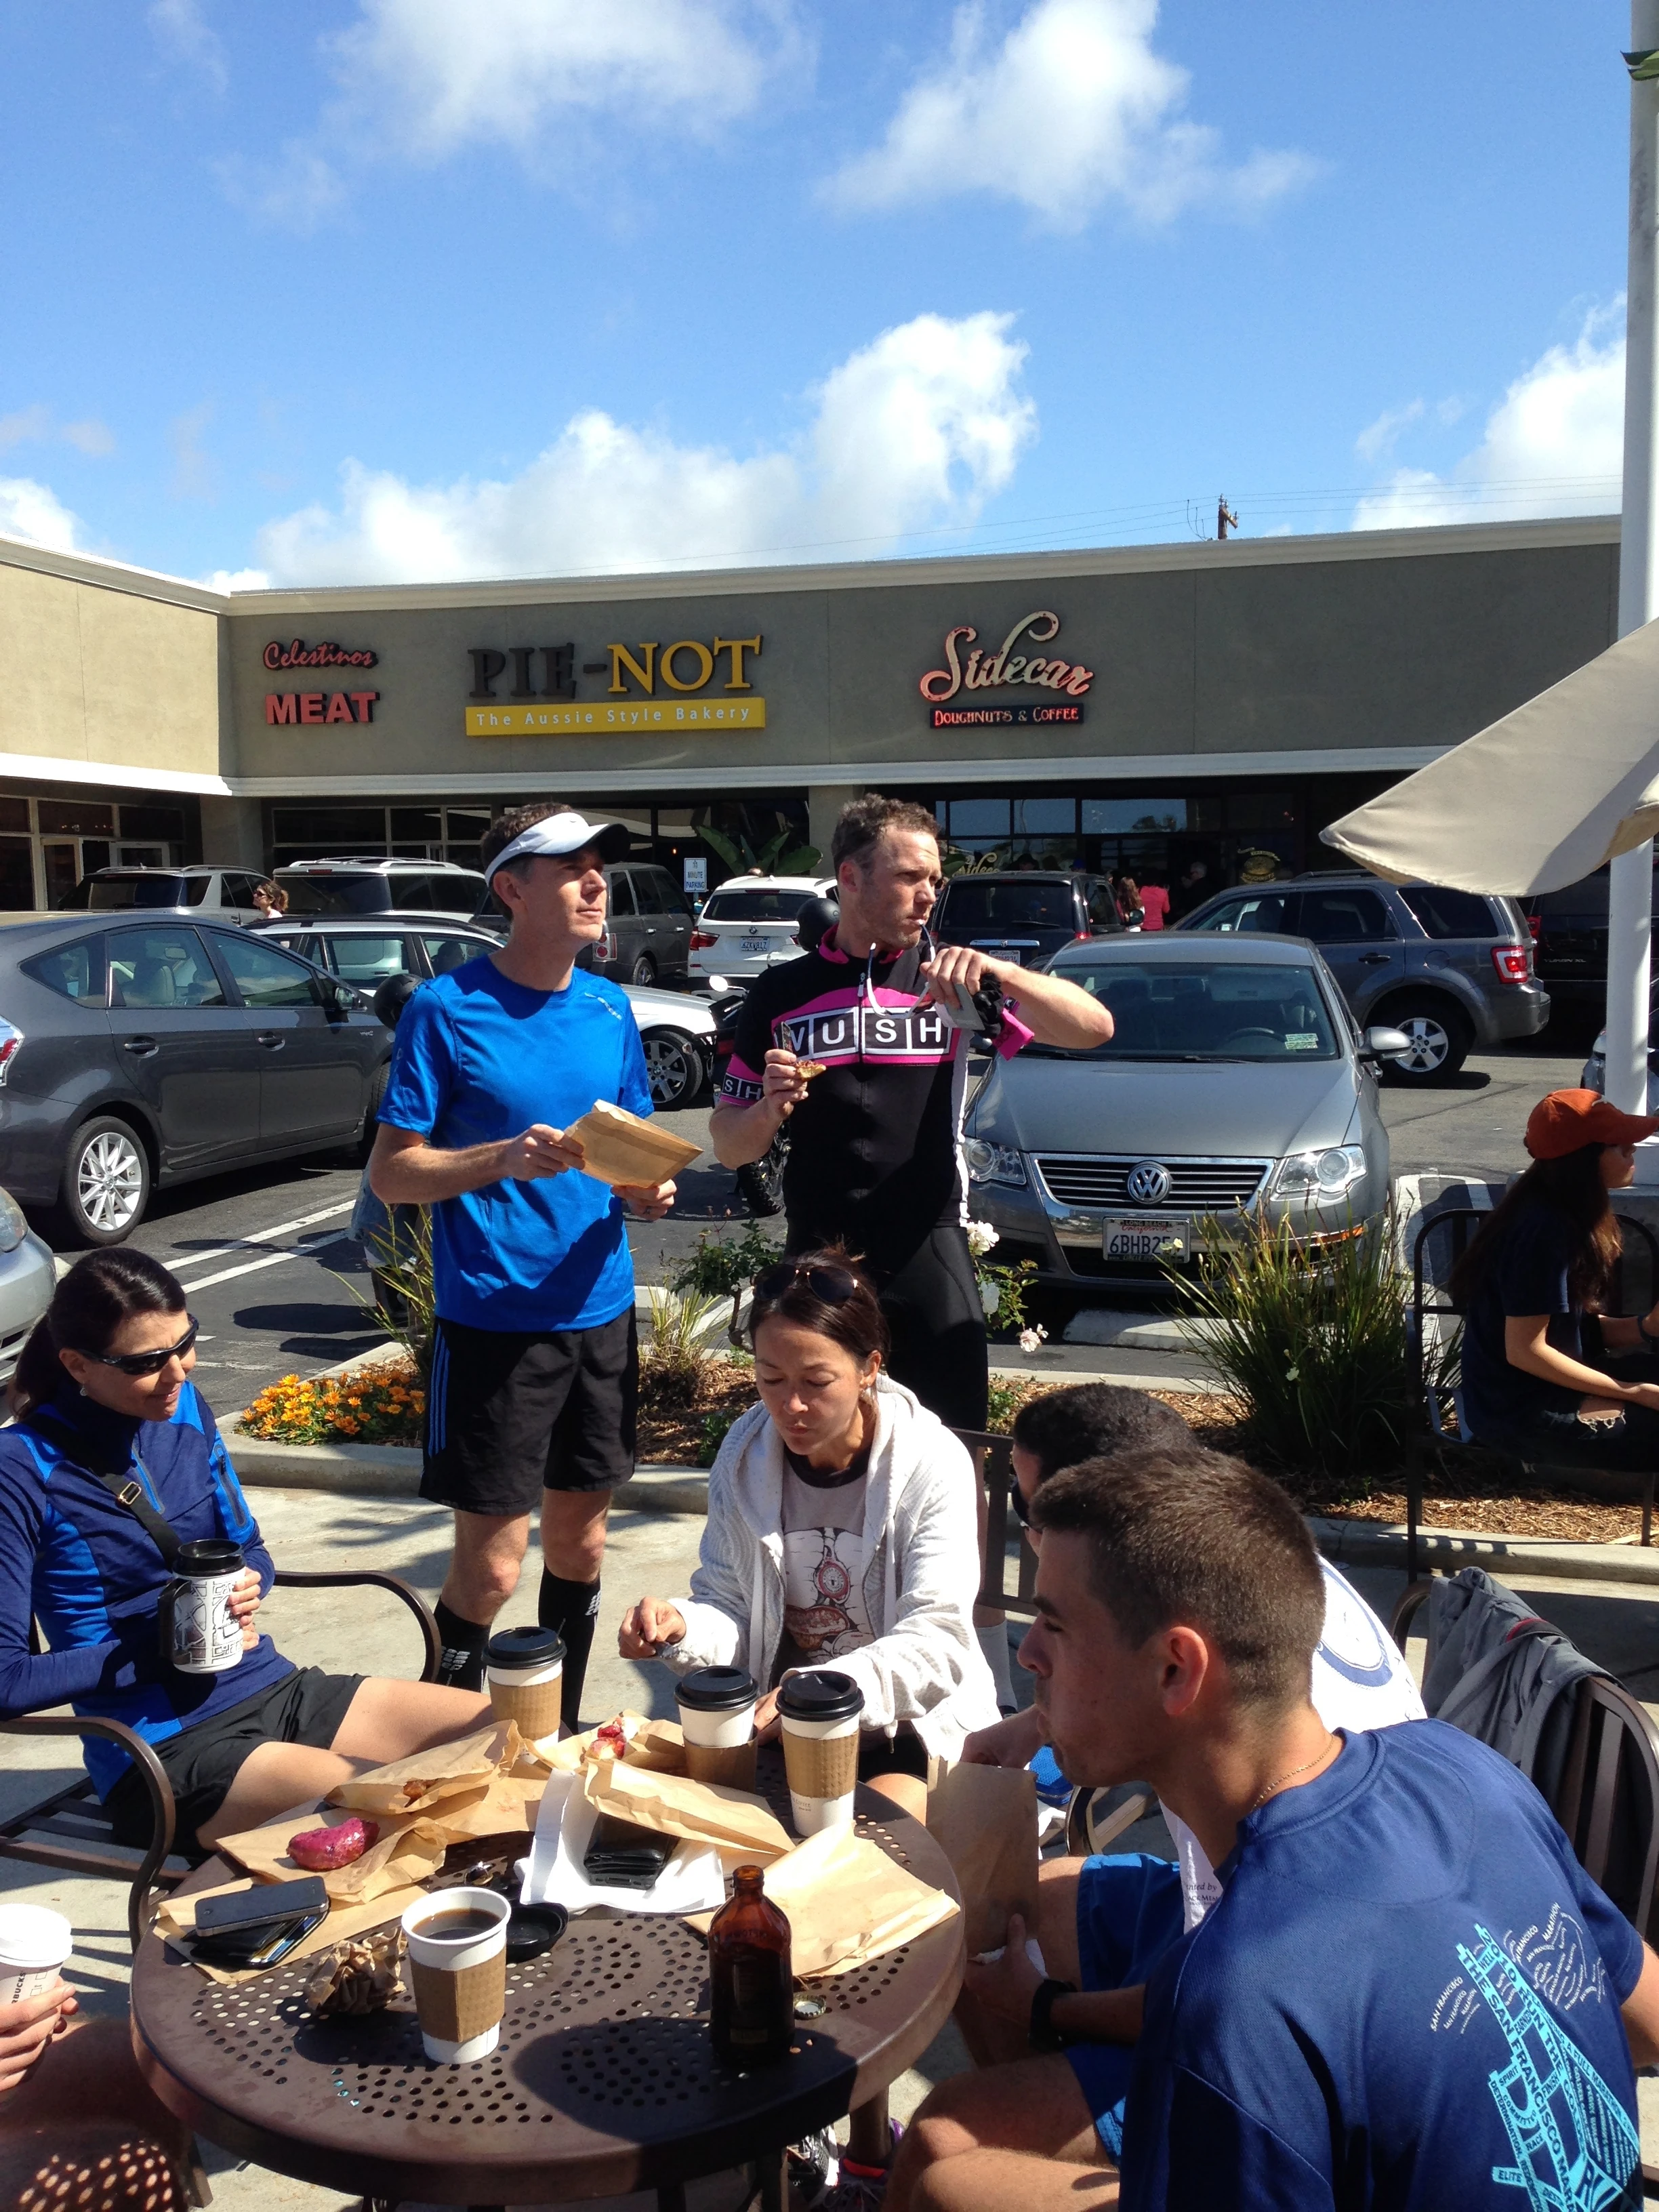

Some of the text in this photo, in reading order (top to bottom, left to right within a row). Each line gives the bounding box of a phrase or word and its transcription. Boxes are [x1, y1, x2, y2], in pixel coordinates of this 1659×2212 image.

[264, 639, 377, 670] Celestinos
[468, 635, 762, 699] PIE-NOT
[920, 611, 1094, 701] Sidecar
[266, 692, 378, 724] MEAT
[476, 707, 749, 726] The Aussie Style Bakery
[1018, 710, 1027, 721] &
[1109, 1235, 1171, 1254] 6BHB2
[1478, 1950, 1496, 1971] WELL
[1430, 1976, 1464, 2032] SAN FRANCISCO
[1462, 1951, 1492, 1994] THE
[1489, 1994, 1515, 2037] SAN
[1511, 2037, 1561, 2155] FRANCISCO
[1544, 2032, 1564, 2076] THE
[1574, 2049, 1592, 2076] FULL
[1498, 2065, 1519, 2087] SPIRIT
[1542, 2072, 1559, 2099] FINISH
[1498, 2169, 1522, 2183] ELITE
